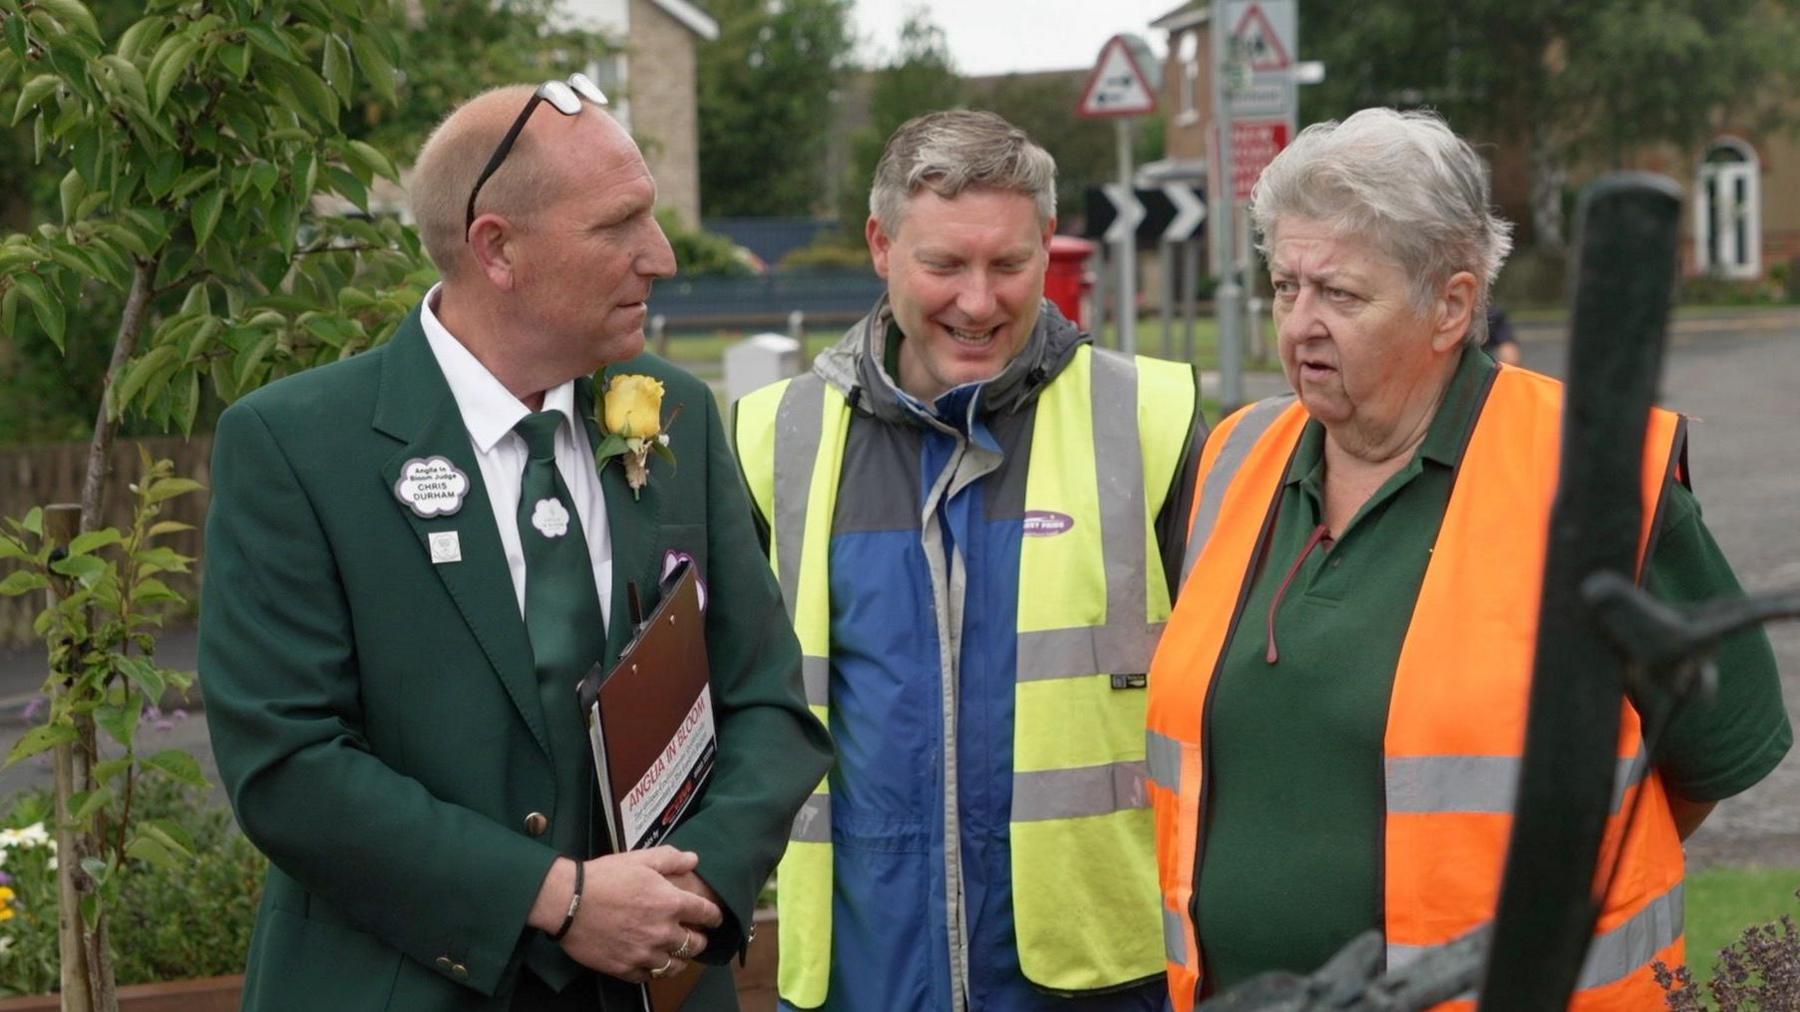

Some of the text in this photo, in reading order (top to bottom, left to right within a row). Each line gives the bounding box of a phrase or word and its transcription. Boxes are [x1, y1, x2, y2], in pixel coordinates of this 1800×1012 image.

[417, 482, 448, 491] CHRIS
[413, 491, 455, 500] DURHAM
[628, 758, 666, 812] ANGLIA
[665, 741, 677, 764] IN
[677, 696, 705, 747] BLOOM
